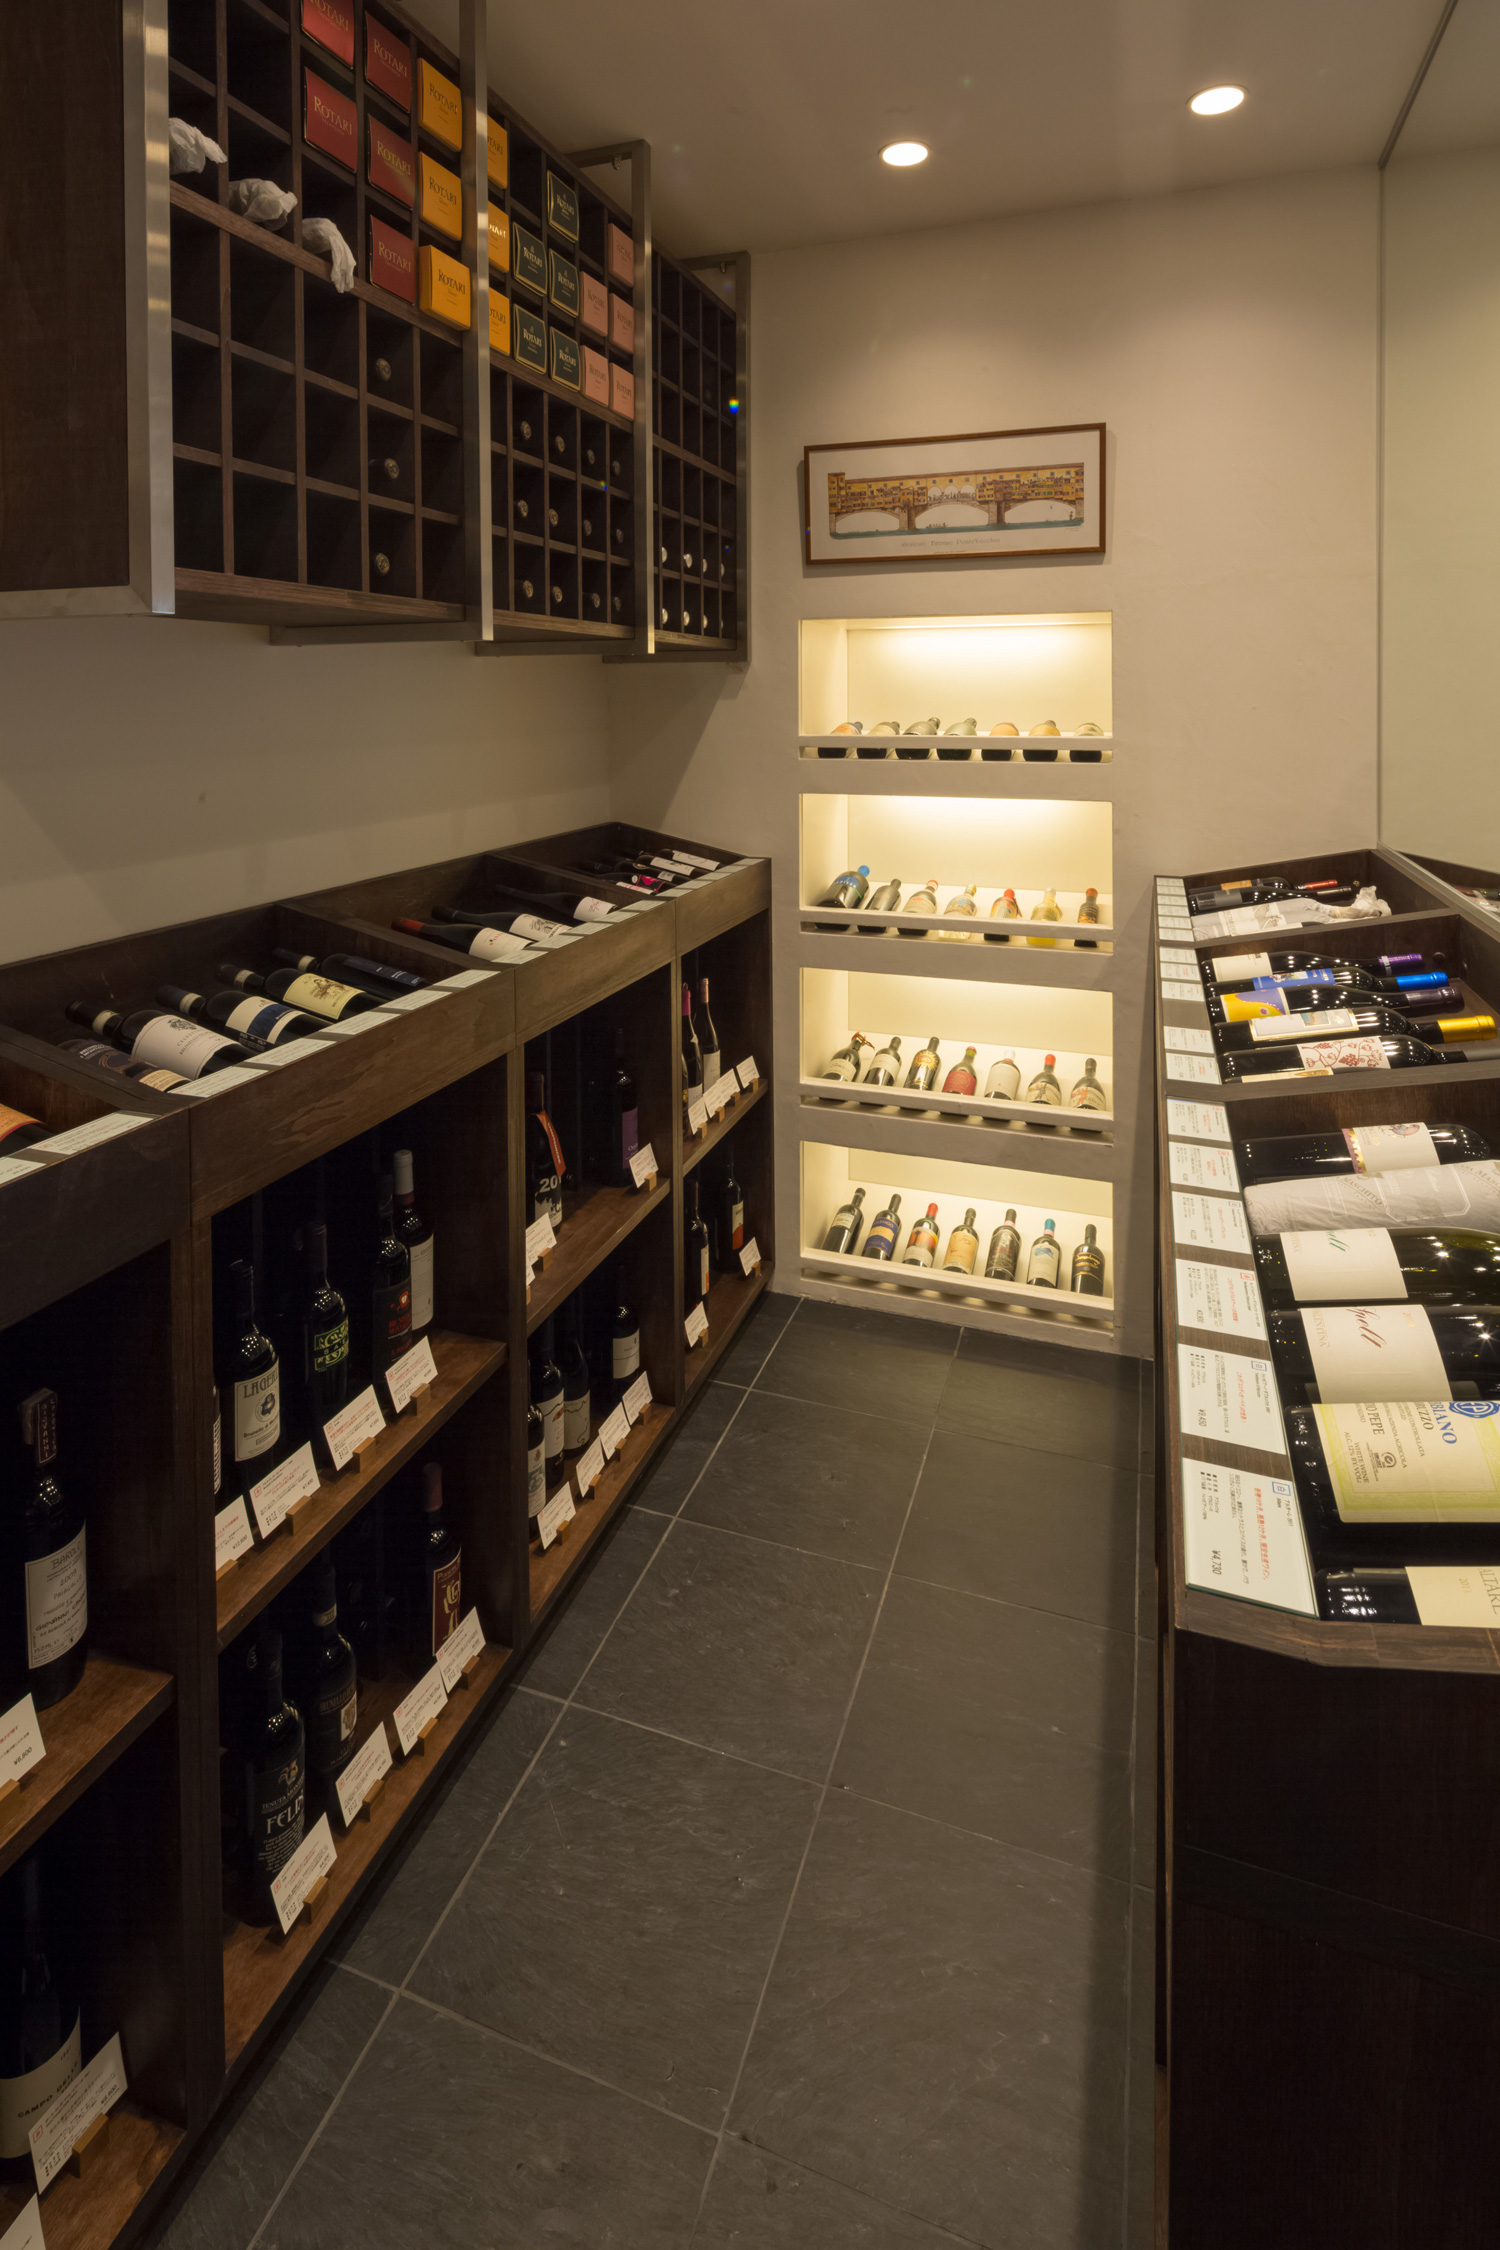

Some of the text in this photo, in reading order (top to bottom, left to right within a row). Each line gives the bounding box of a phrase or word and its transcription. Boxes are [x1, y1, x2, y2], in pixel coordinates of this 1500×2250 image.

[374, 38, 408, 77] ROTARI
[429, 83, 458, 114] ROTARI
[314, 96, 352, 135] ROTARI
[377, 141, 411, 176] ROTARI
[429, 176, 457, 205] ROTARI
[378, 241, 411, 273] ROTARI
[523, 246, 542, 268] ROTARI
[438, 269, 466, 295] ROTARI
[557, 274, 575, 292] ROTARI
[523, 327, 542, 348] ROTARI
[559, 348, 576, 367] ROTARI
[1343, 1177, 1383, 1206] MASCHITO
[1197, 1408, 1207, 1427] ¥9,450
[1367, 1413, 1385, 1435] PEPE
[1408, 1418, 1425, 1456] CONTROLLATA
[1353, 1442, 1369, 1483] WHITE WINE
[1393, 1438, 1408, 1468] AGRICOLA
[1210, 1548, 1222, 1576] ¥4,730
[18, 2094, 53, 2119] CAMPO
